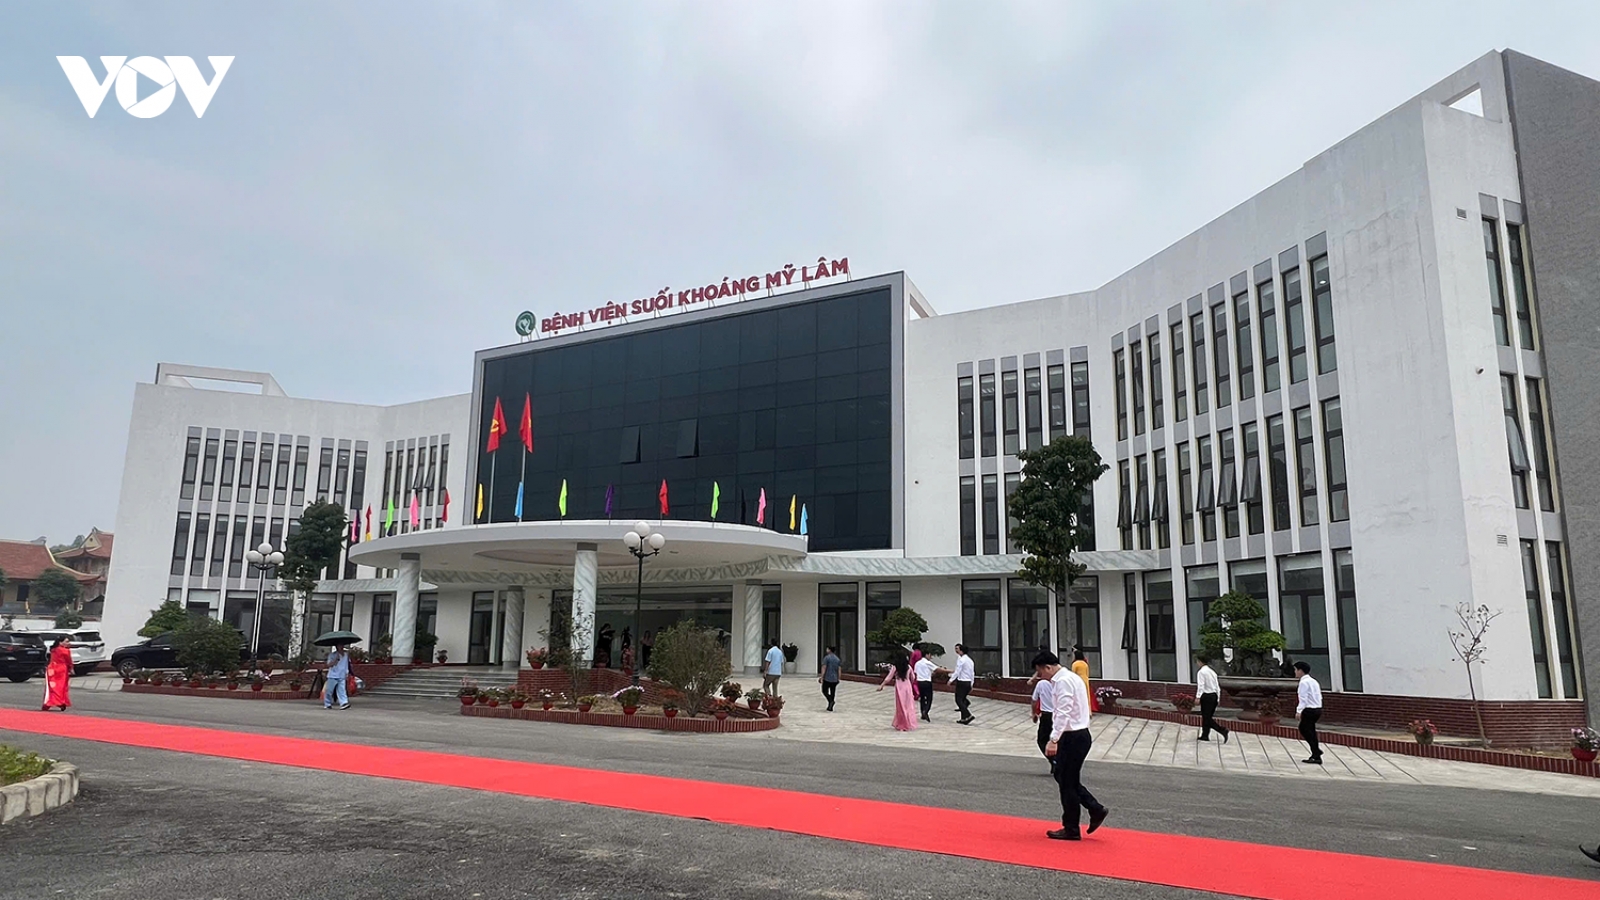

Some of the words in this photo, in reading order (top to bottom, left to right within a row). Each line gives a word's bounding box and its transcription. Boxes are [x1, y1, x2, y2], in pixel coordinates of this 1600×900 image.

[541, 312, 585, 335] BỆNH
[588, 301, 628, 325] VIỆN
[631, 286, 674, 315] SUỐI
[678, 276, 760, 307] KHOÁNG
[766, 263, 797, 289] MỸ
[802, 256, 849, 282] LÂM
